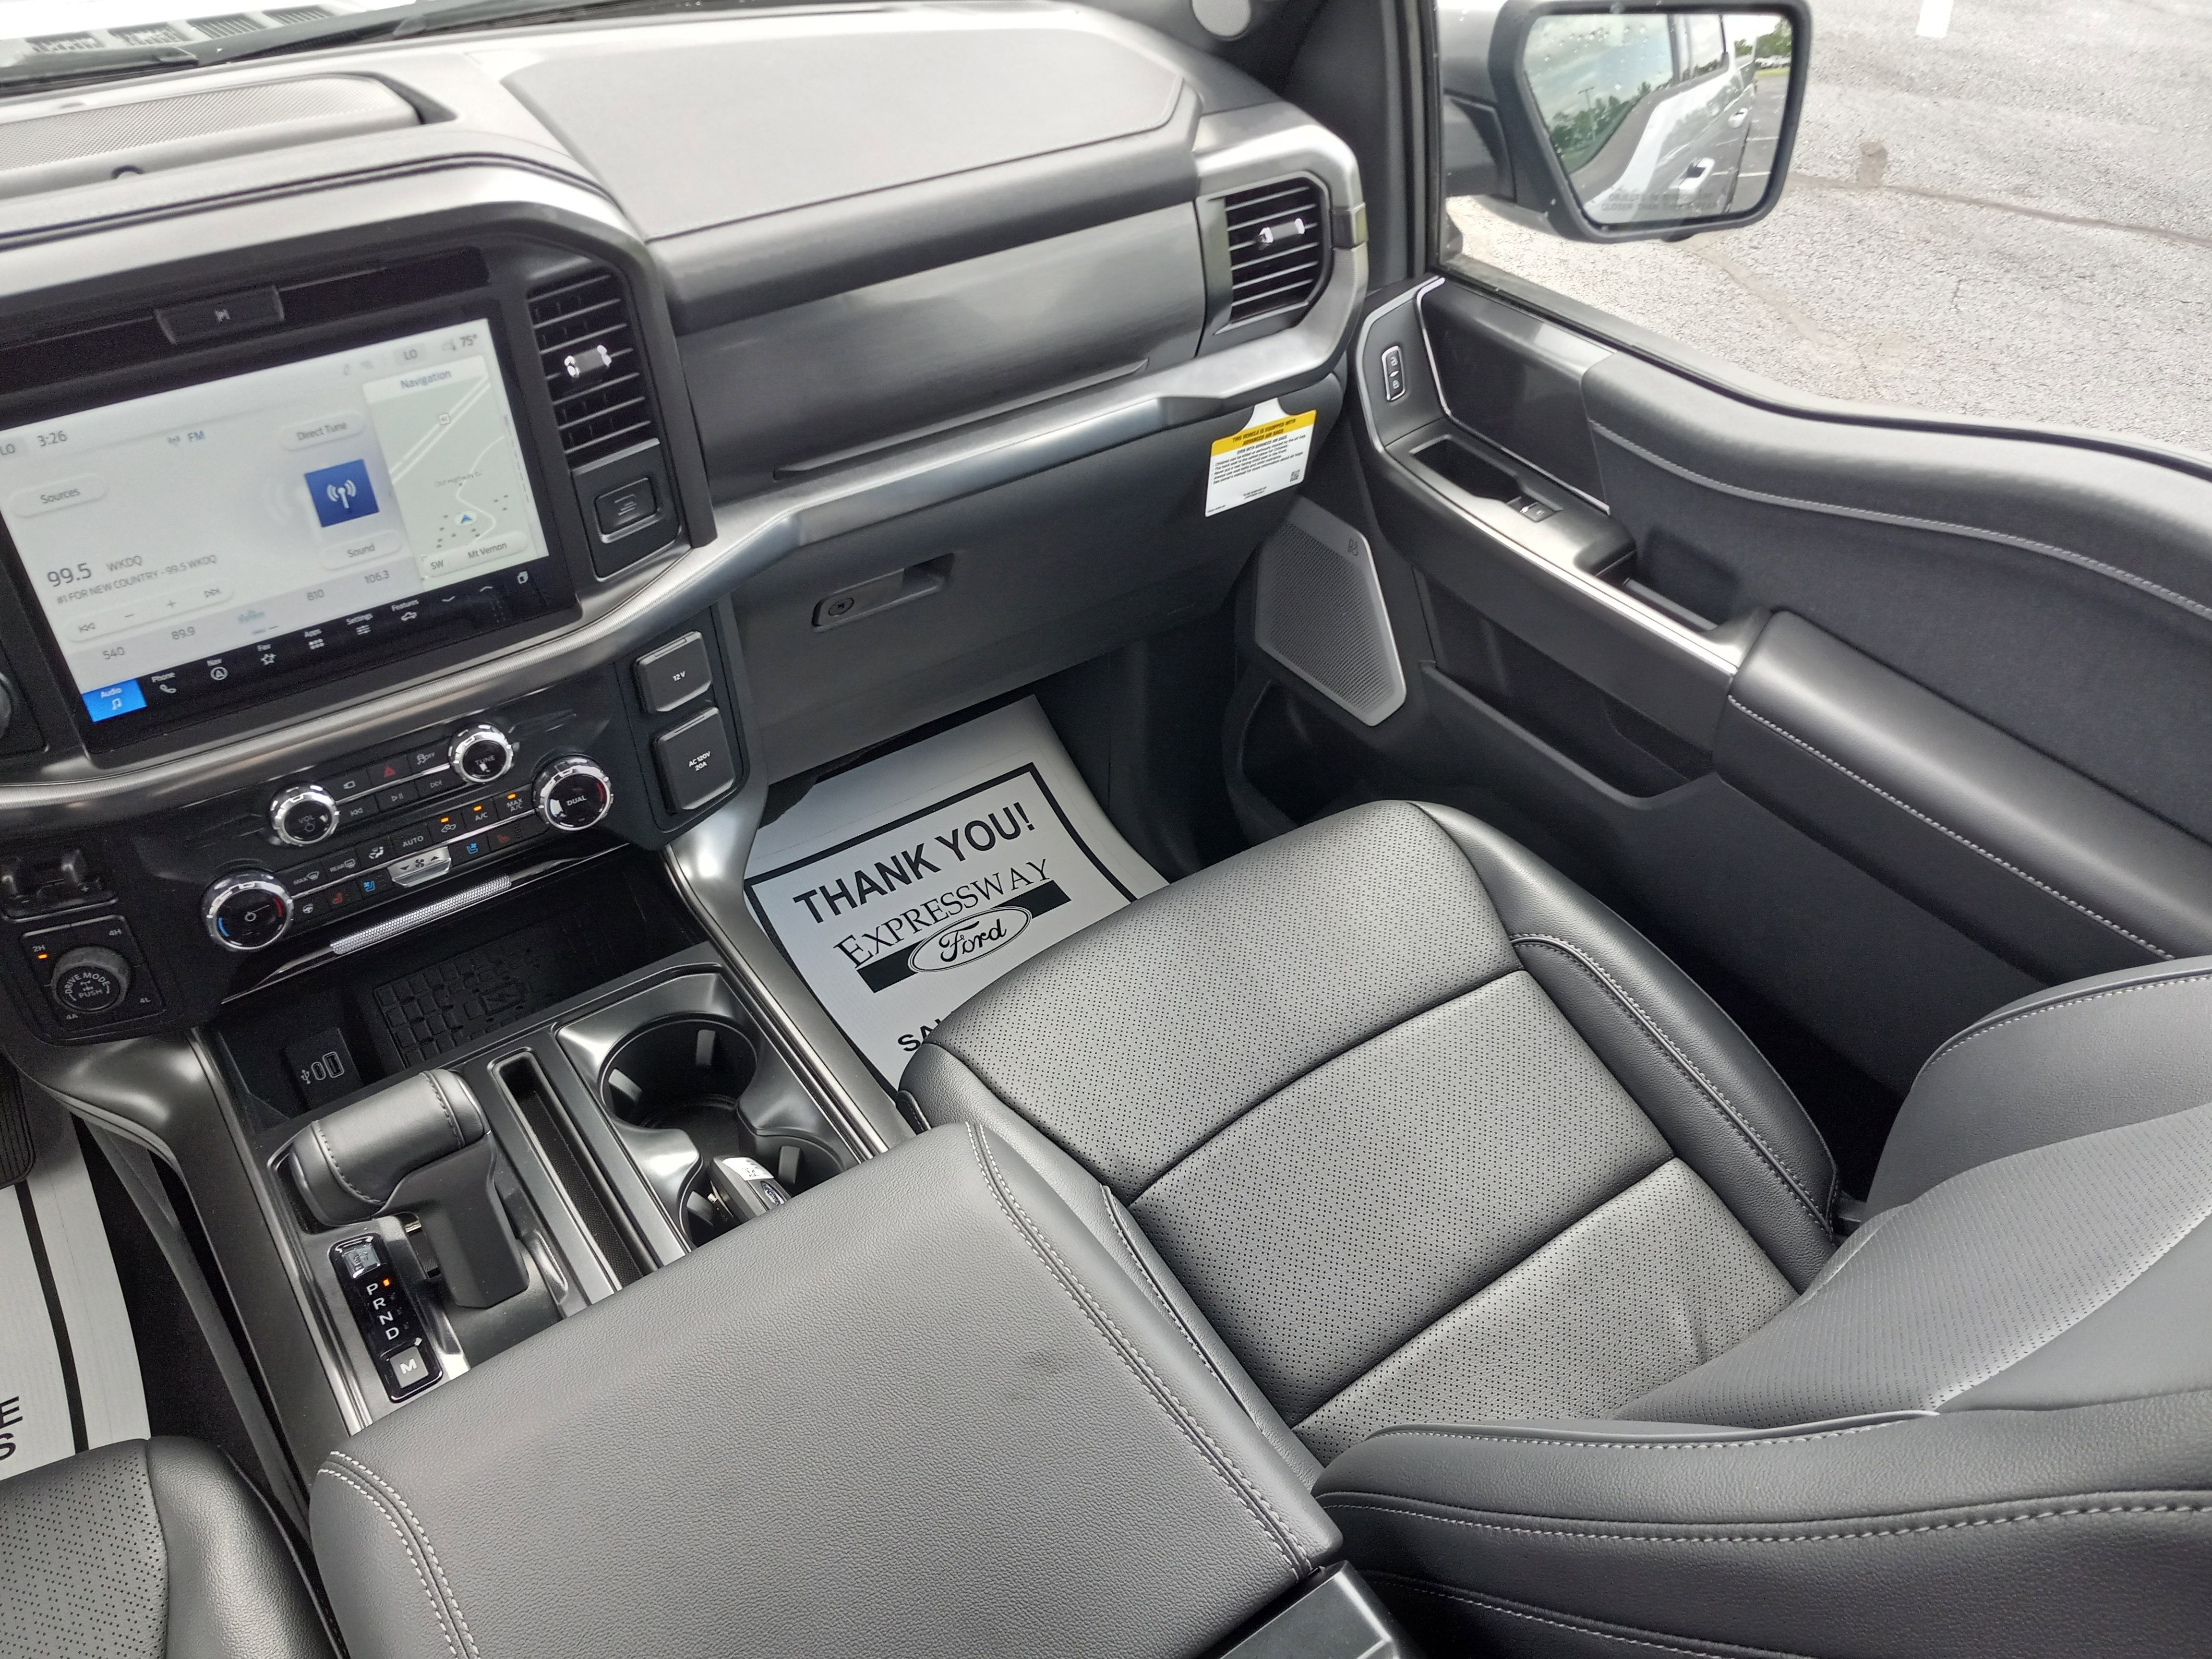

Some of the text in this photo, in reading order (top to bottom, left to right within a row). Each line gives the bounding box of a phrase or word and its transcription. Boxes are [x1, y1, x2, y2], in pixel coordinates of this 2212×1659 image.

[404, 349, 418, 360] LO
[400, 370, 452, 389] Navigation
[37, 431, 67, 447] 3:26
[297, 427, 325, 441] Direct
[40, 489, 81, 504] Sources
[347, 543, 375, 558] Sound
[468, 542, 507, 559] Mt Vernon
[47, 555, 143, 587] 99.5 WKDQ
[430, 559, 444, 570] SW
[365, 570, 390, 584] 106.3
[68, 589, 88, 601] FOR
[89, 582, 112, 596] NEW
[113, 570, 158, 589] COUNTRY
[307, 589, 325, 601] 810
[391, 599, 420, 612] Features
[171, 626, 196, 640] 89.9
[102, 647, 125, 660] 540
[151, 672, 176, 683] Phone
[100, 687, 122, 699] Audio
[475, 754, 496, 766] TUNE
[688, 750, 711, 767] AC 120V
[695, 761, 708, 772] 20A
[507, 798, 523, 808] MAX
[566, 795, 587, 806] DUAL
[510, 804, 523, 812] A/C
[298, 815, 315, 824] VOL
[475, 812, 488, 821] A/C
[402, 835, 424, 848] AUTO
[330, 863, 345, 873] REAR
[793, 802, 1035, 924] THANK YOU!
[293, 877, 308, 885] MAX
[833, 859, 1050, 969] EXPRESSWAY
[108, 928, 122, 937] 4H
[938, 918, 1007, 962] Ford
[32, 944, 46, 952] 2H
[65, 972, 111, 995] DRIVE MODE
[78, 989, 103, 998] PUSH
[898, 1018, 941, 1052] SA
[366, 1282, 378, 1296] P
[373, 1297, 386, 1310] R
[379, 1311, 393, 1325] N
[385, 1326, 399, 1341] D
[400, 1358, 417, 1374] M
